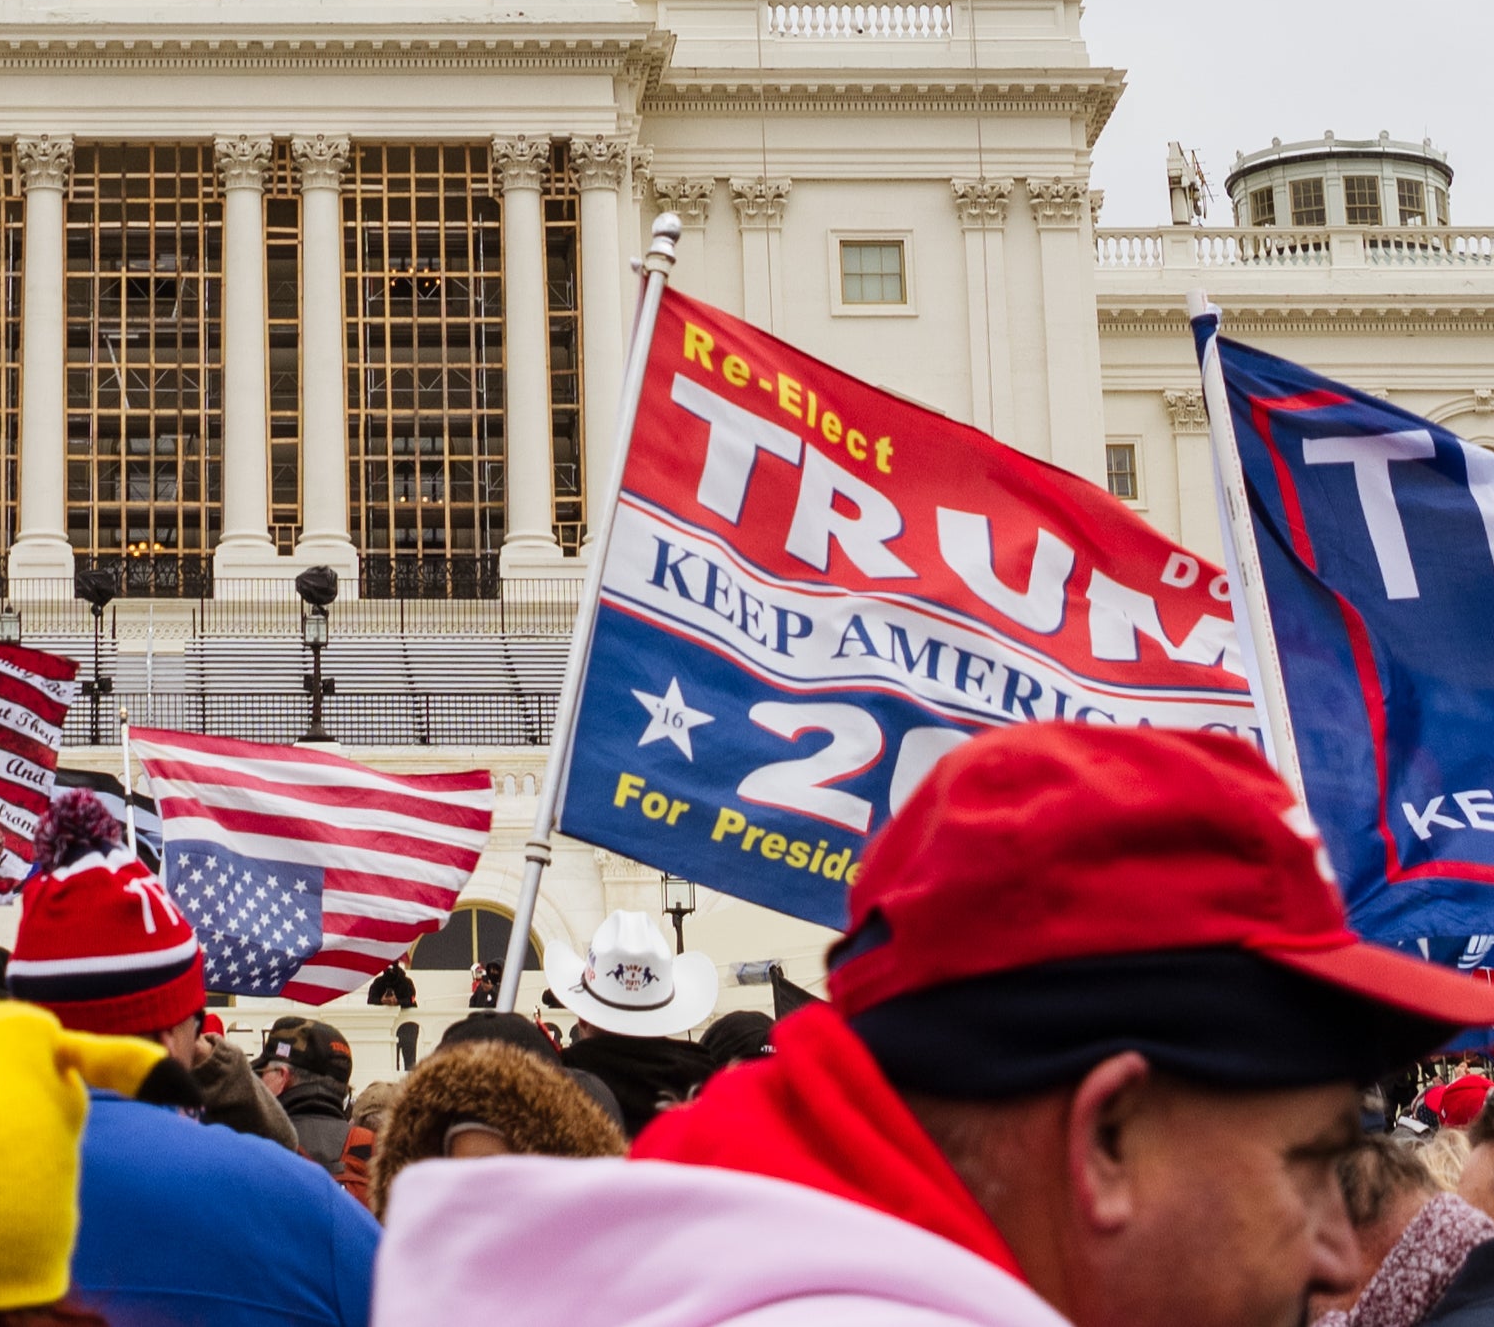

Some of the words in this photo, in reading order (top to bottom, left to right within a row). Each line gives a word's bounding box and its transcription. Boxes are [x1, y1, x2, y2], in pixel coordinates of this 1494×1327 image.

[682, 321, 894, 474] Re-Elect
[669, 371, 1250, 678] TRUM
[647, 535, 815, 659] KEEP
[15, 709, 57, 746] They
[40, 676, 68, 697] Be
[5, 757, 47, 788] And
[613, 771, 691, 829] For
[710, 806, 865, 890] Preside
